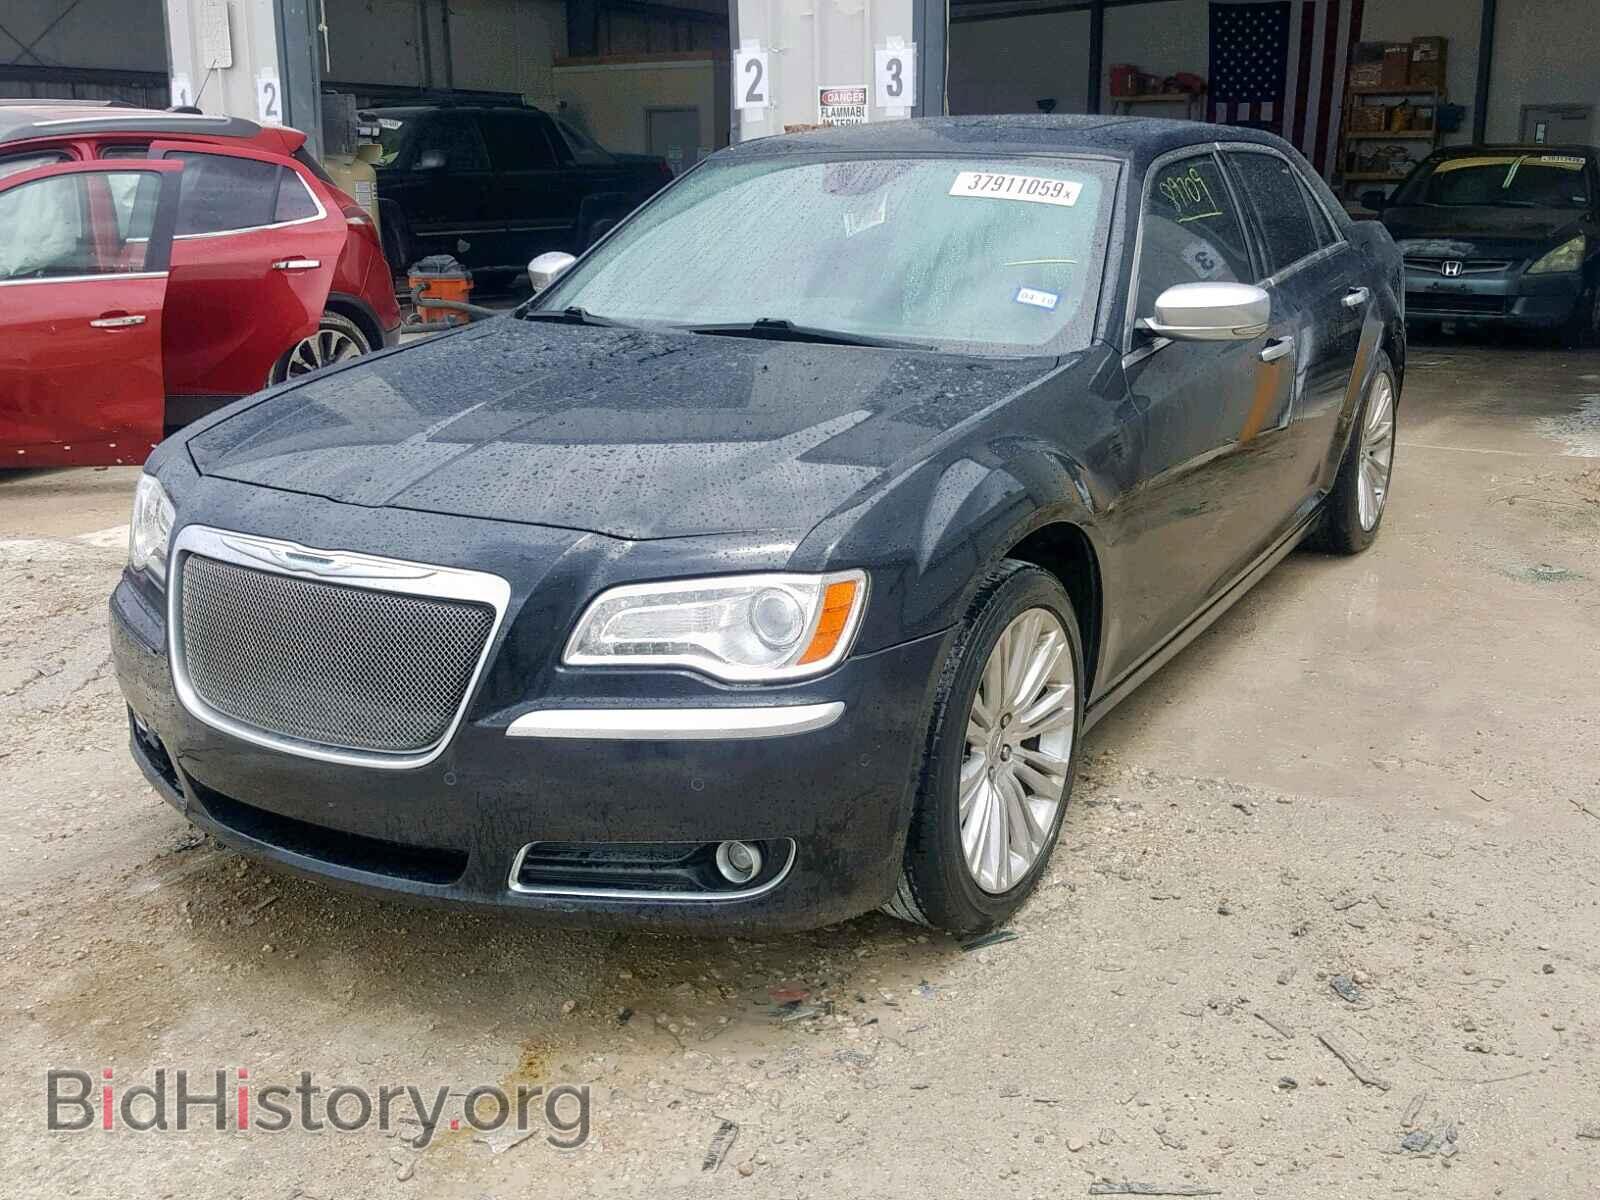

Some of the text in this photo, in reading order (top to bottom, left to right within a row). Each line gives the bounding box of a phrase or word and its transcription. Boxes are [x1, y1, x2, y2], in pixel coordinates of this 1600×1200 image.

[745, 58, 764, 103] 2
[886, 58, 903, 97] 3
[263, 82, 278, 117] 2
[827, 92, 865, 103] DANGER
